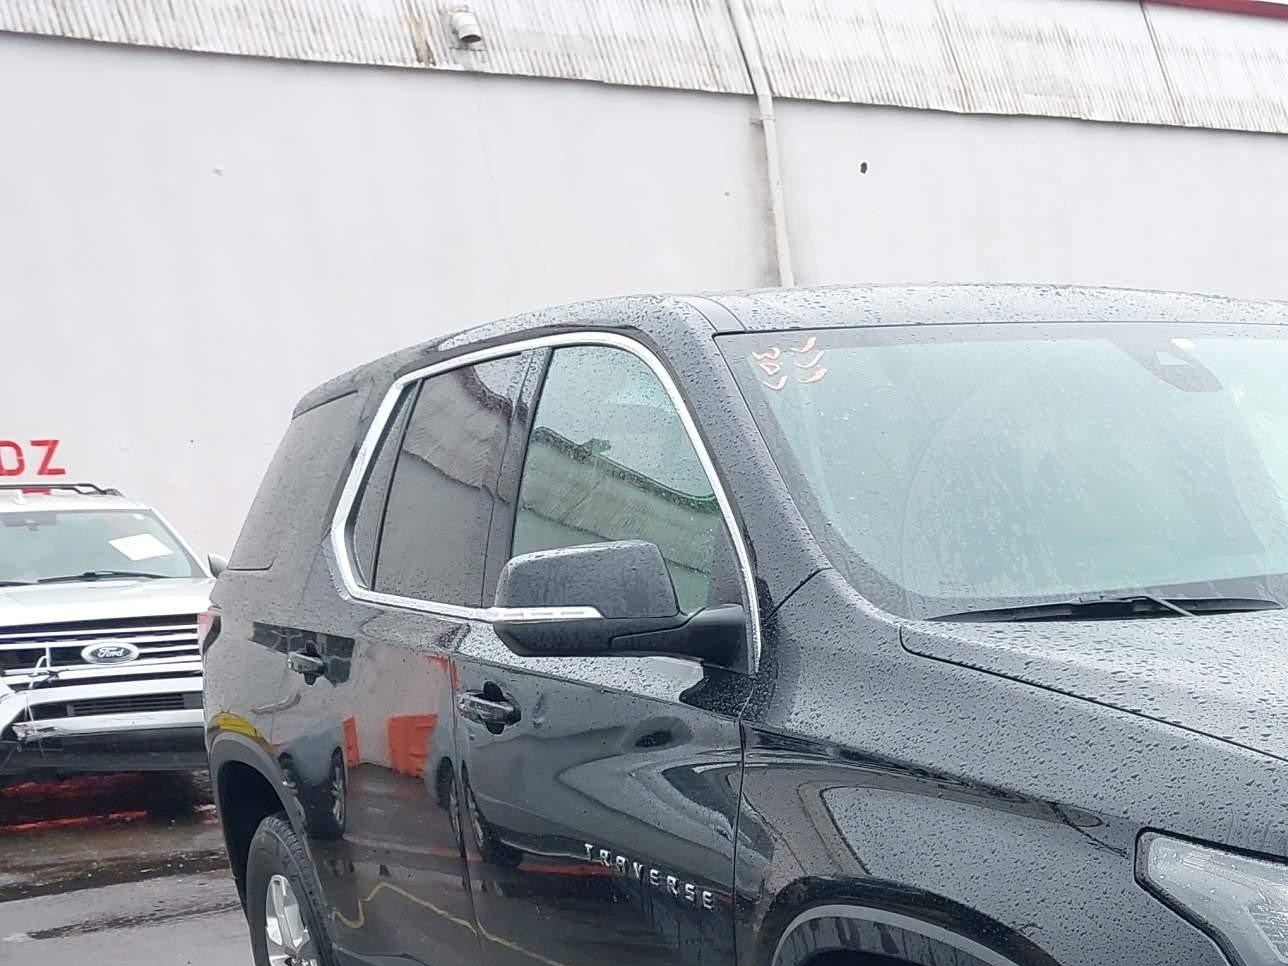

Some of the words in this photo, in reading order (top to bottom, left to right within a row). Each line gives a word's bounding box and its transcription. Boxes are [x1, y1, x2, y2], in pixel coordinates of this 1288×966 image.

[0, 440, 66, 476] DZ
[97, 647, 125, 658] Ford
[584, 842, 715, 911] TRAVERSE
